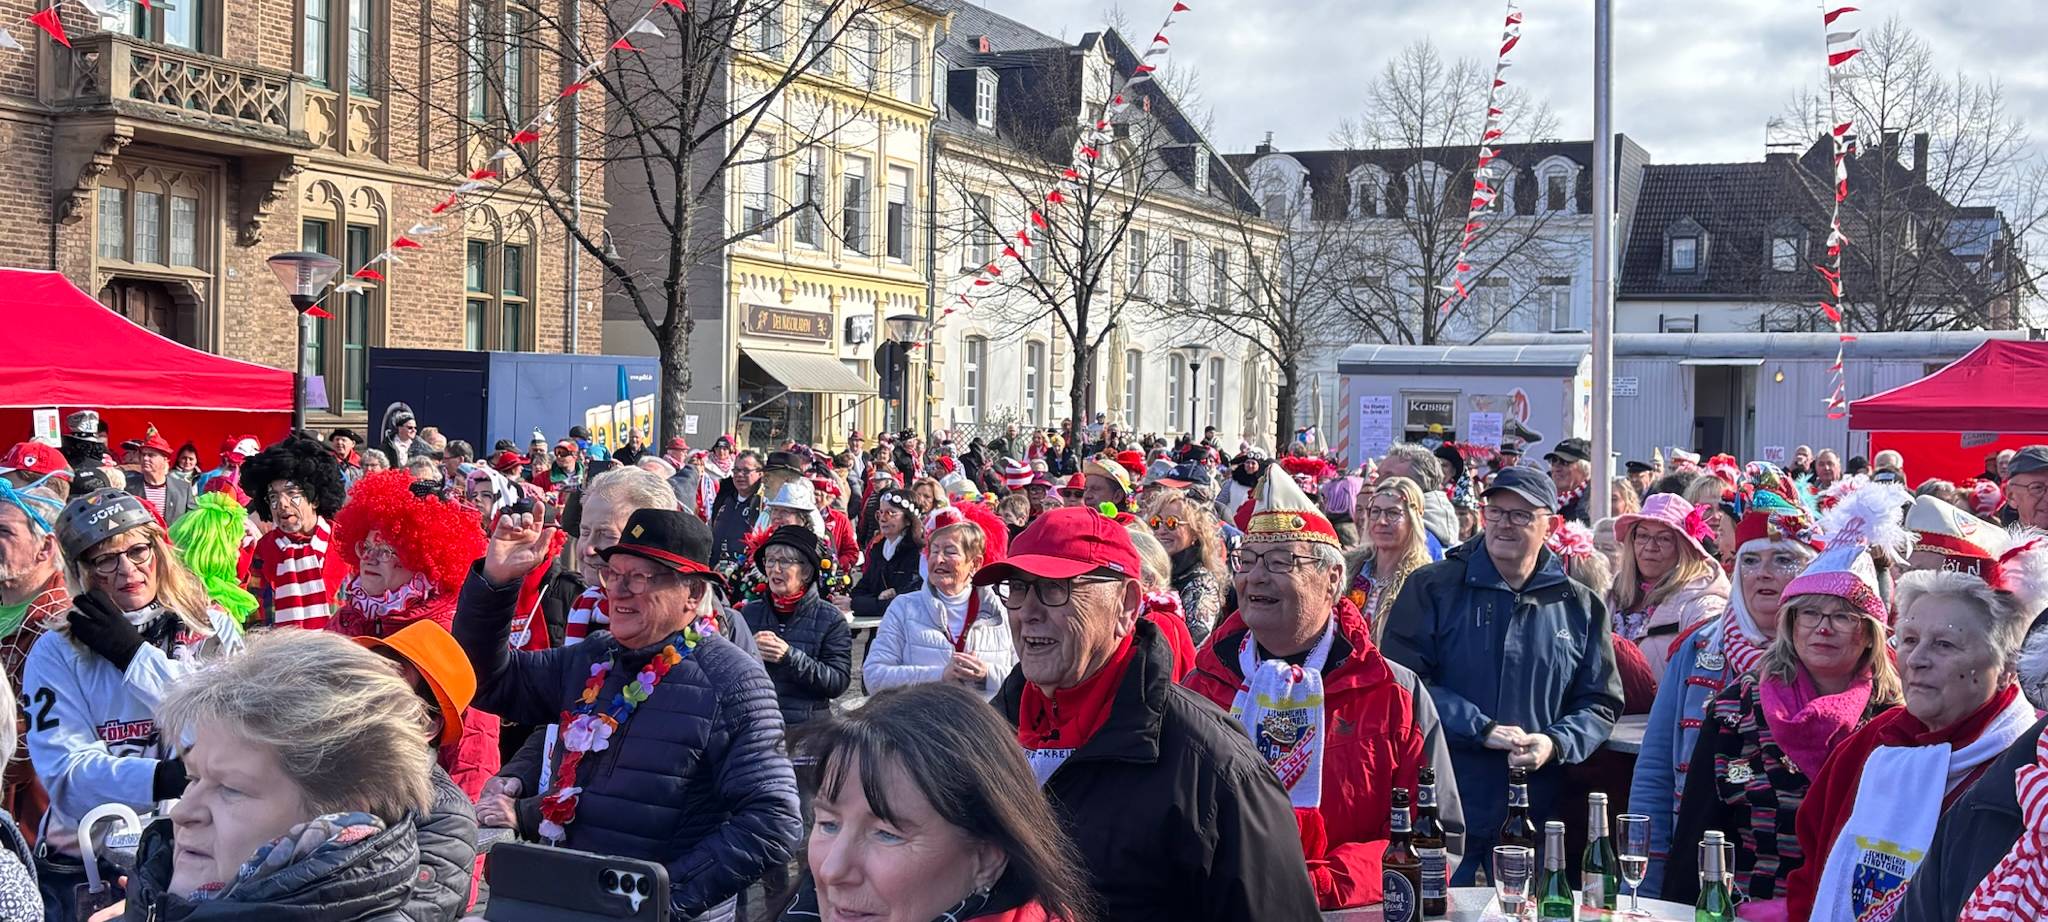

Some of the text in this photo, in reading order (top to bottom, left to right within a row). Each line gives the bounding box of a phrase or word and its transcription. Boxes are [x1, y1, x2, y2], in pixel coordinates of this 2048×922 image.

[1410, 400, 1450, 411] Kasse
[1765, 448, 1783, 460] WC
[88, 503, 125, 525] JOFA
[97, 721, 154, 742] KÖLNE
